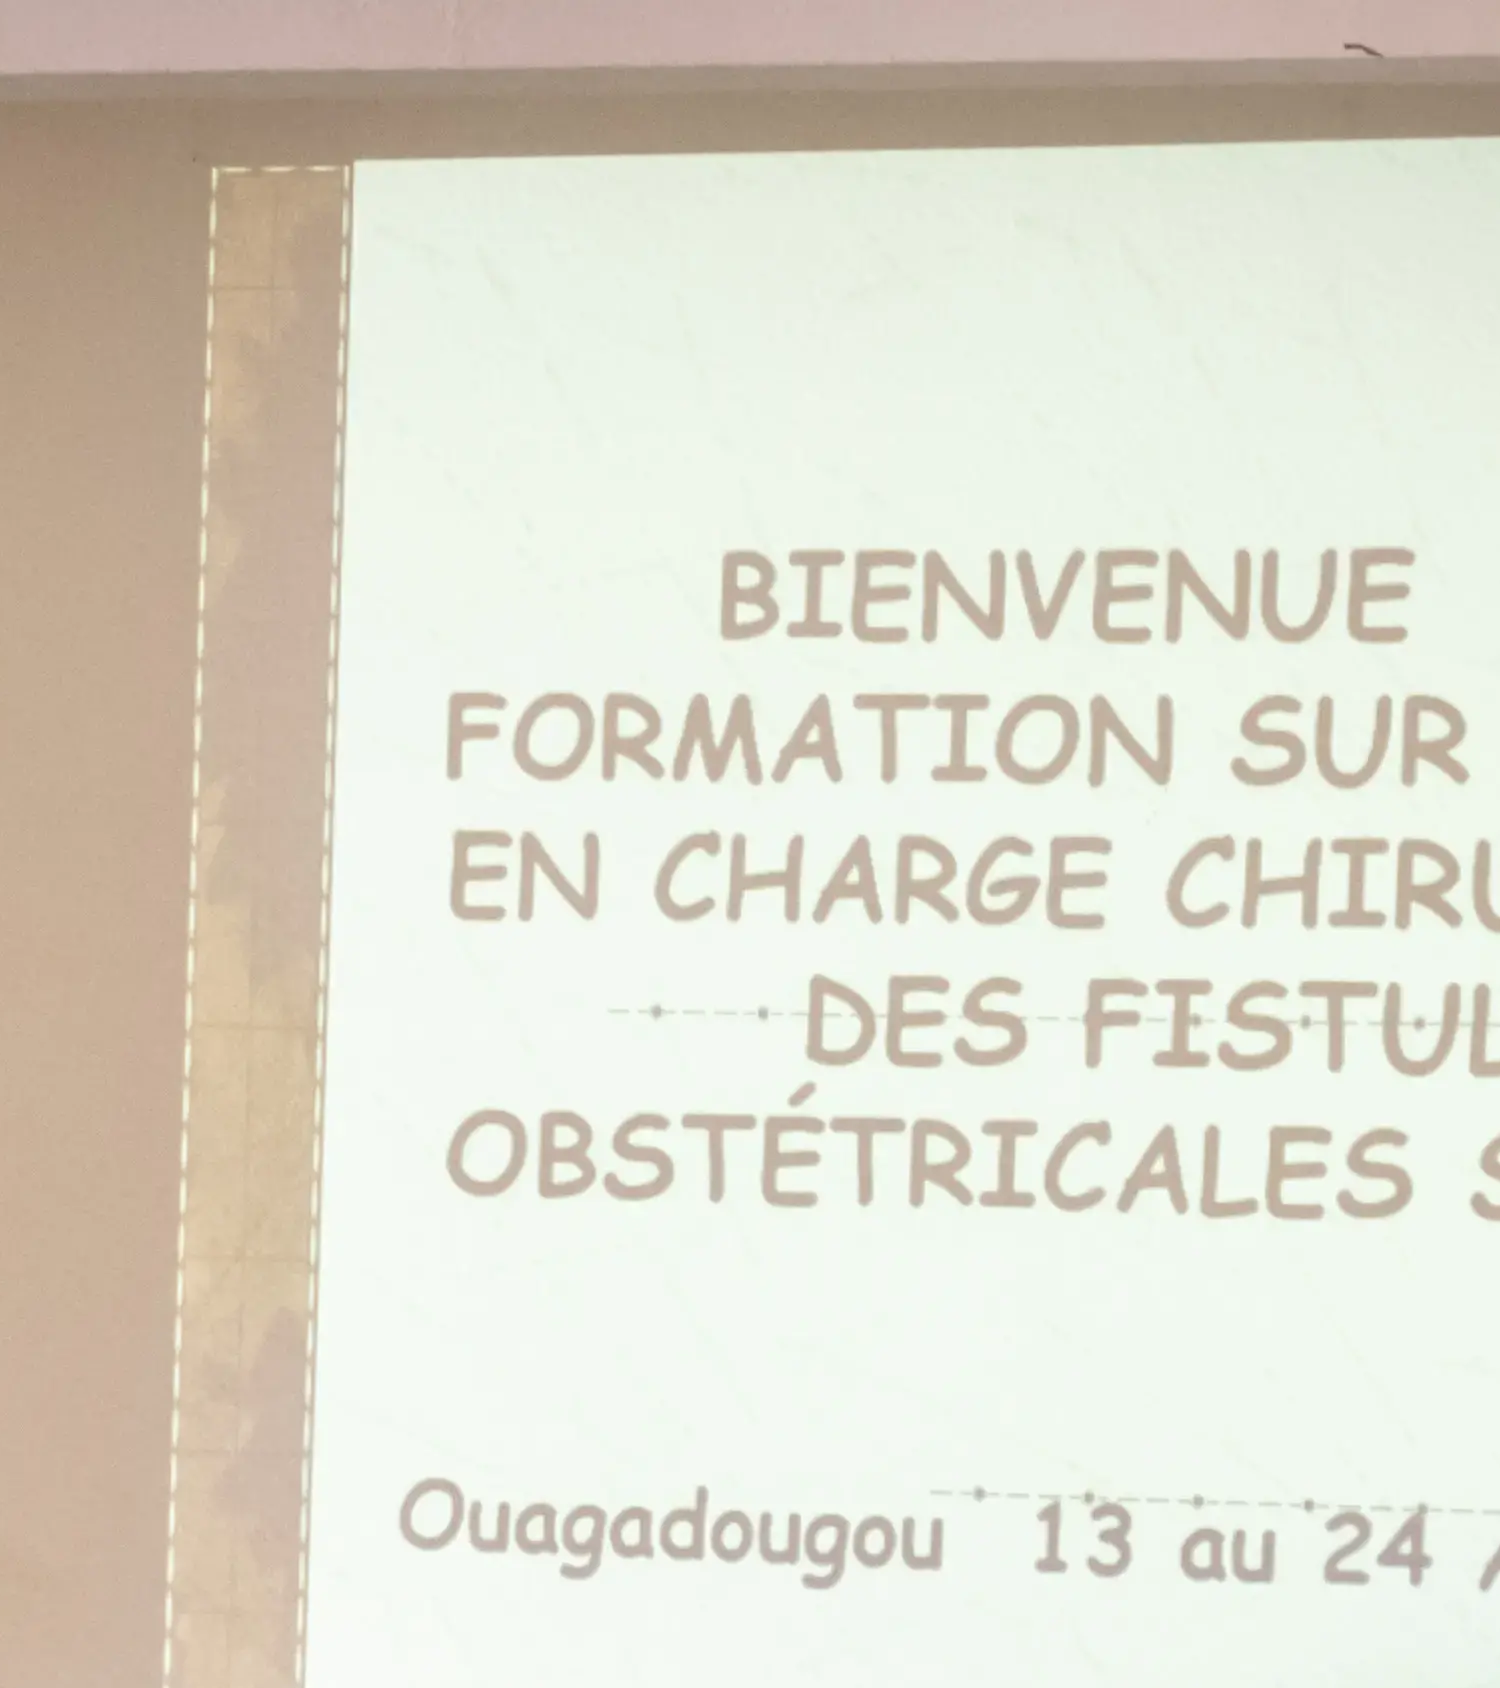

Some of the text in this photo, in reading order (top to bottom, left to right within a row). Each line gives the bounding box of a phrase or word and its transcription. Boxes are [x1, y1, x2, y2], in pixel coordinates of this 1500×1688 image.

[719, 546, 1417, 645] BIENVENUE
[446, 691, 1175, 789] FORMATION
[1230, 694, 1470, 790] SUR
[449, 829, 601, 922] EN
[653, 829, 1113, 930] CHARGE
[805, 974, 1028, 1069] DES
[445, 1082, 1414, 1221] OBSTÉTRICALES
[398, 1477, 944, 1591] Ouagadougou
[1034, 1500, 1133, 1579] 13
[1179, 1526, 1277, 1585] au
[1323, 1511, 1433, 1588] 24
